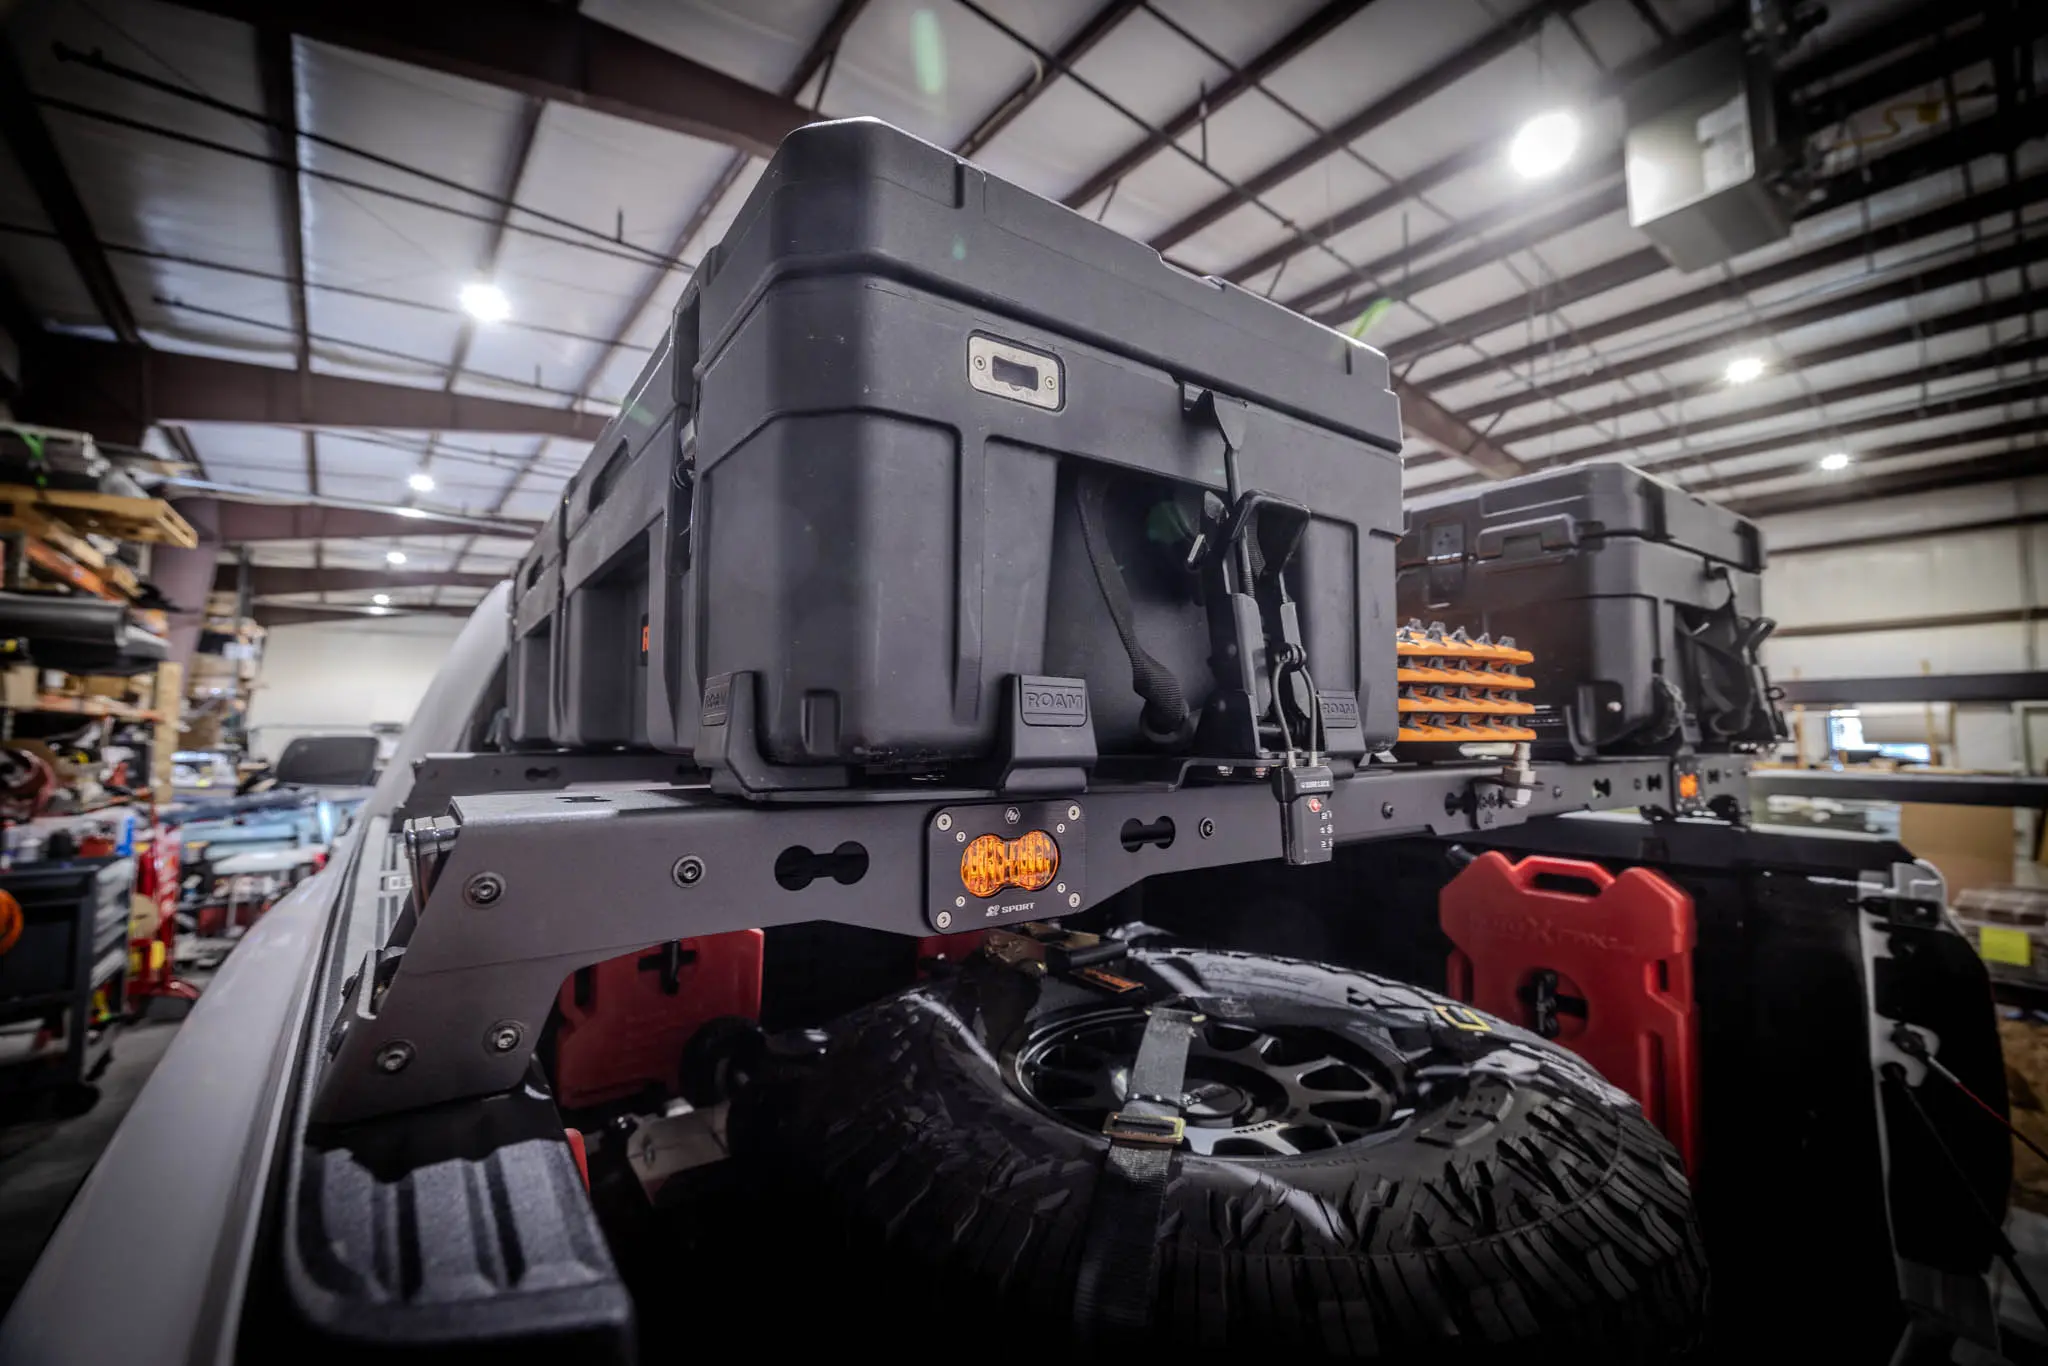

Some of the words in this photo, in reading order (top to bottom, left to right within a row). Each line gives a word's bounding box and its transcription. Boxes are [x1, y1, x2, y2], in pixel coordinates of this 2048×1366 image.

[1025, 692, 1084, 709] ROAM
[1322, 703, 1356, 714] ROAM
[1001, 902, 1036, 914] SPORT
